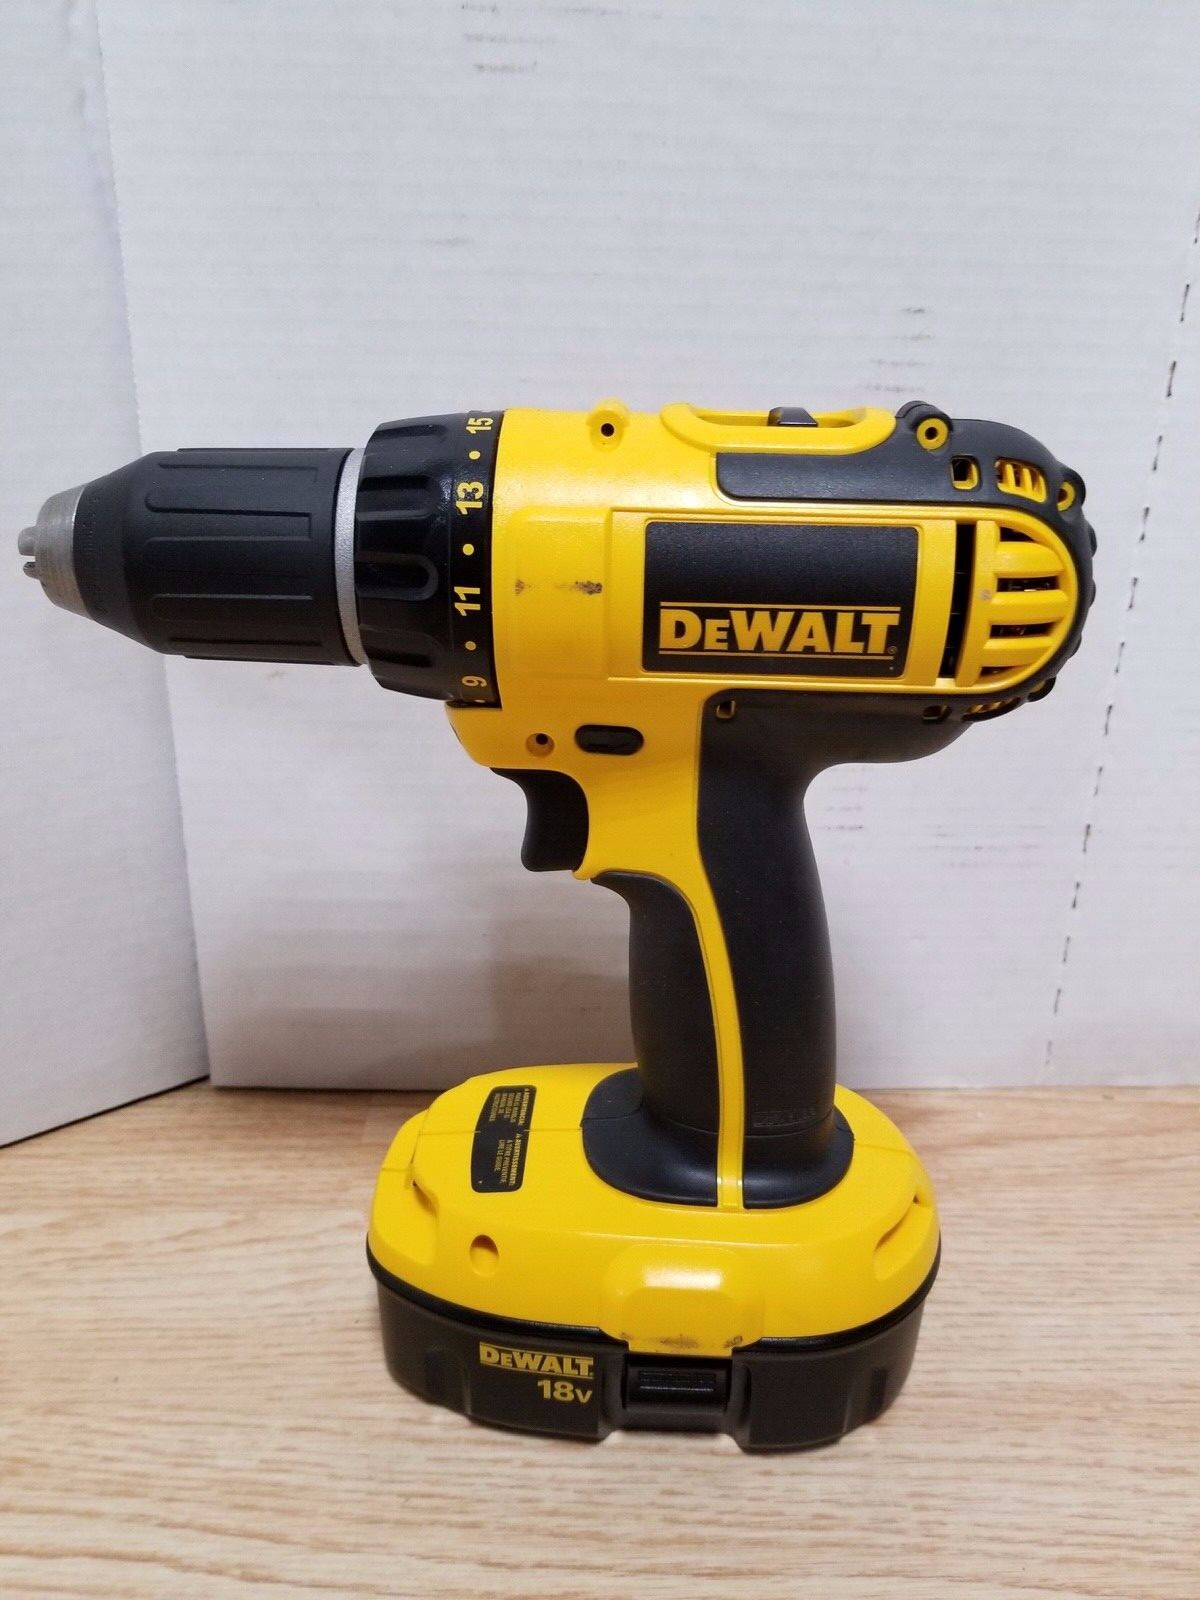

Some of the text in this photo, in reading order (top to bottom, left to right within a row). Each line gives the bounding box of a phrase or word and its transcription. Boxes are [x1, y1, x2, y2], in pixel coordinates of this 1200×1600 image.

[466, 416, 493, 433] 15
[456, 480, 484, 515] 13
[454, 586, 481, 617] 11
[462, 676, 488, 688] 9
